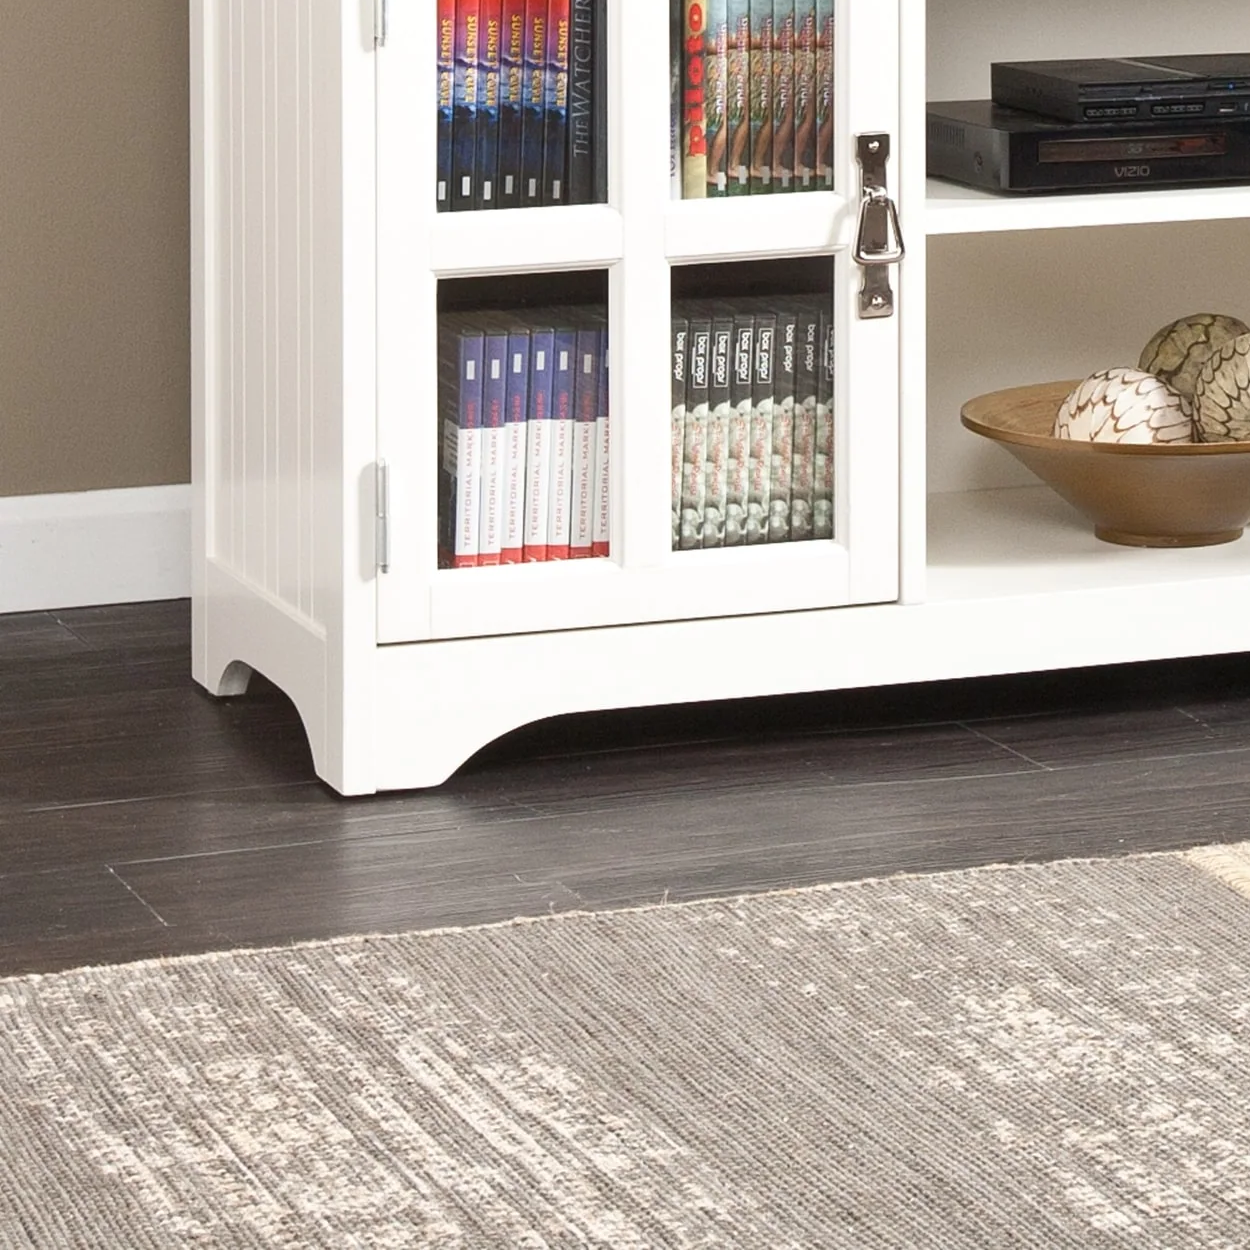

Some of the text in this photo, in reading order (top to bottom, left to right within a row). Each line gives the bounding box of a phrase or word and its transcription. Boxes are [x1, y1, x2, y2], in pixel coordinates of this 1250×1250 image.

[441, 19, 452, 67] SUNSET
[467, 16, 477, 64] SUNSET
[488, 20, 498, 69] SUNSET
[511, 14, 521, 62] SUNSET
[533, 17, 544, 65] SUNSET
[557, 19, 567, 69] SUNSET
[1114, 166, 1150, 177] VIZIO
[675, 331, 686, 351] box
[740, 332, 751, 351] box
[761, 331, 771, 350] box
[785, 324, 794, 343] box
[806, 324, 816, 342] box
[697, 336, 707, 355] box
[718, 335, 728, 354] box
